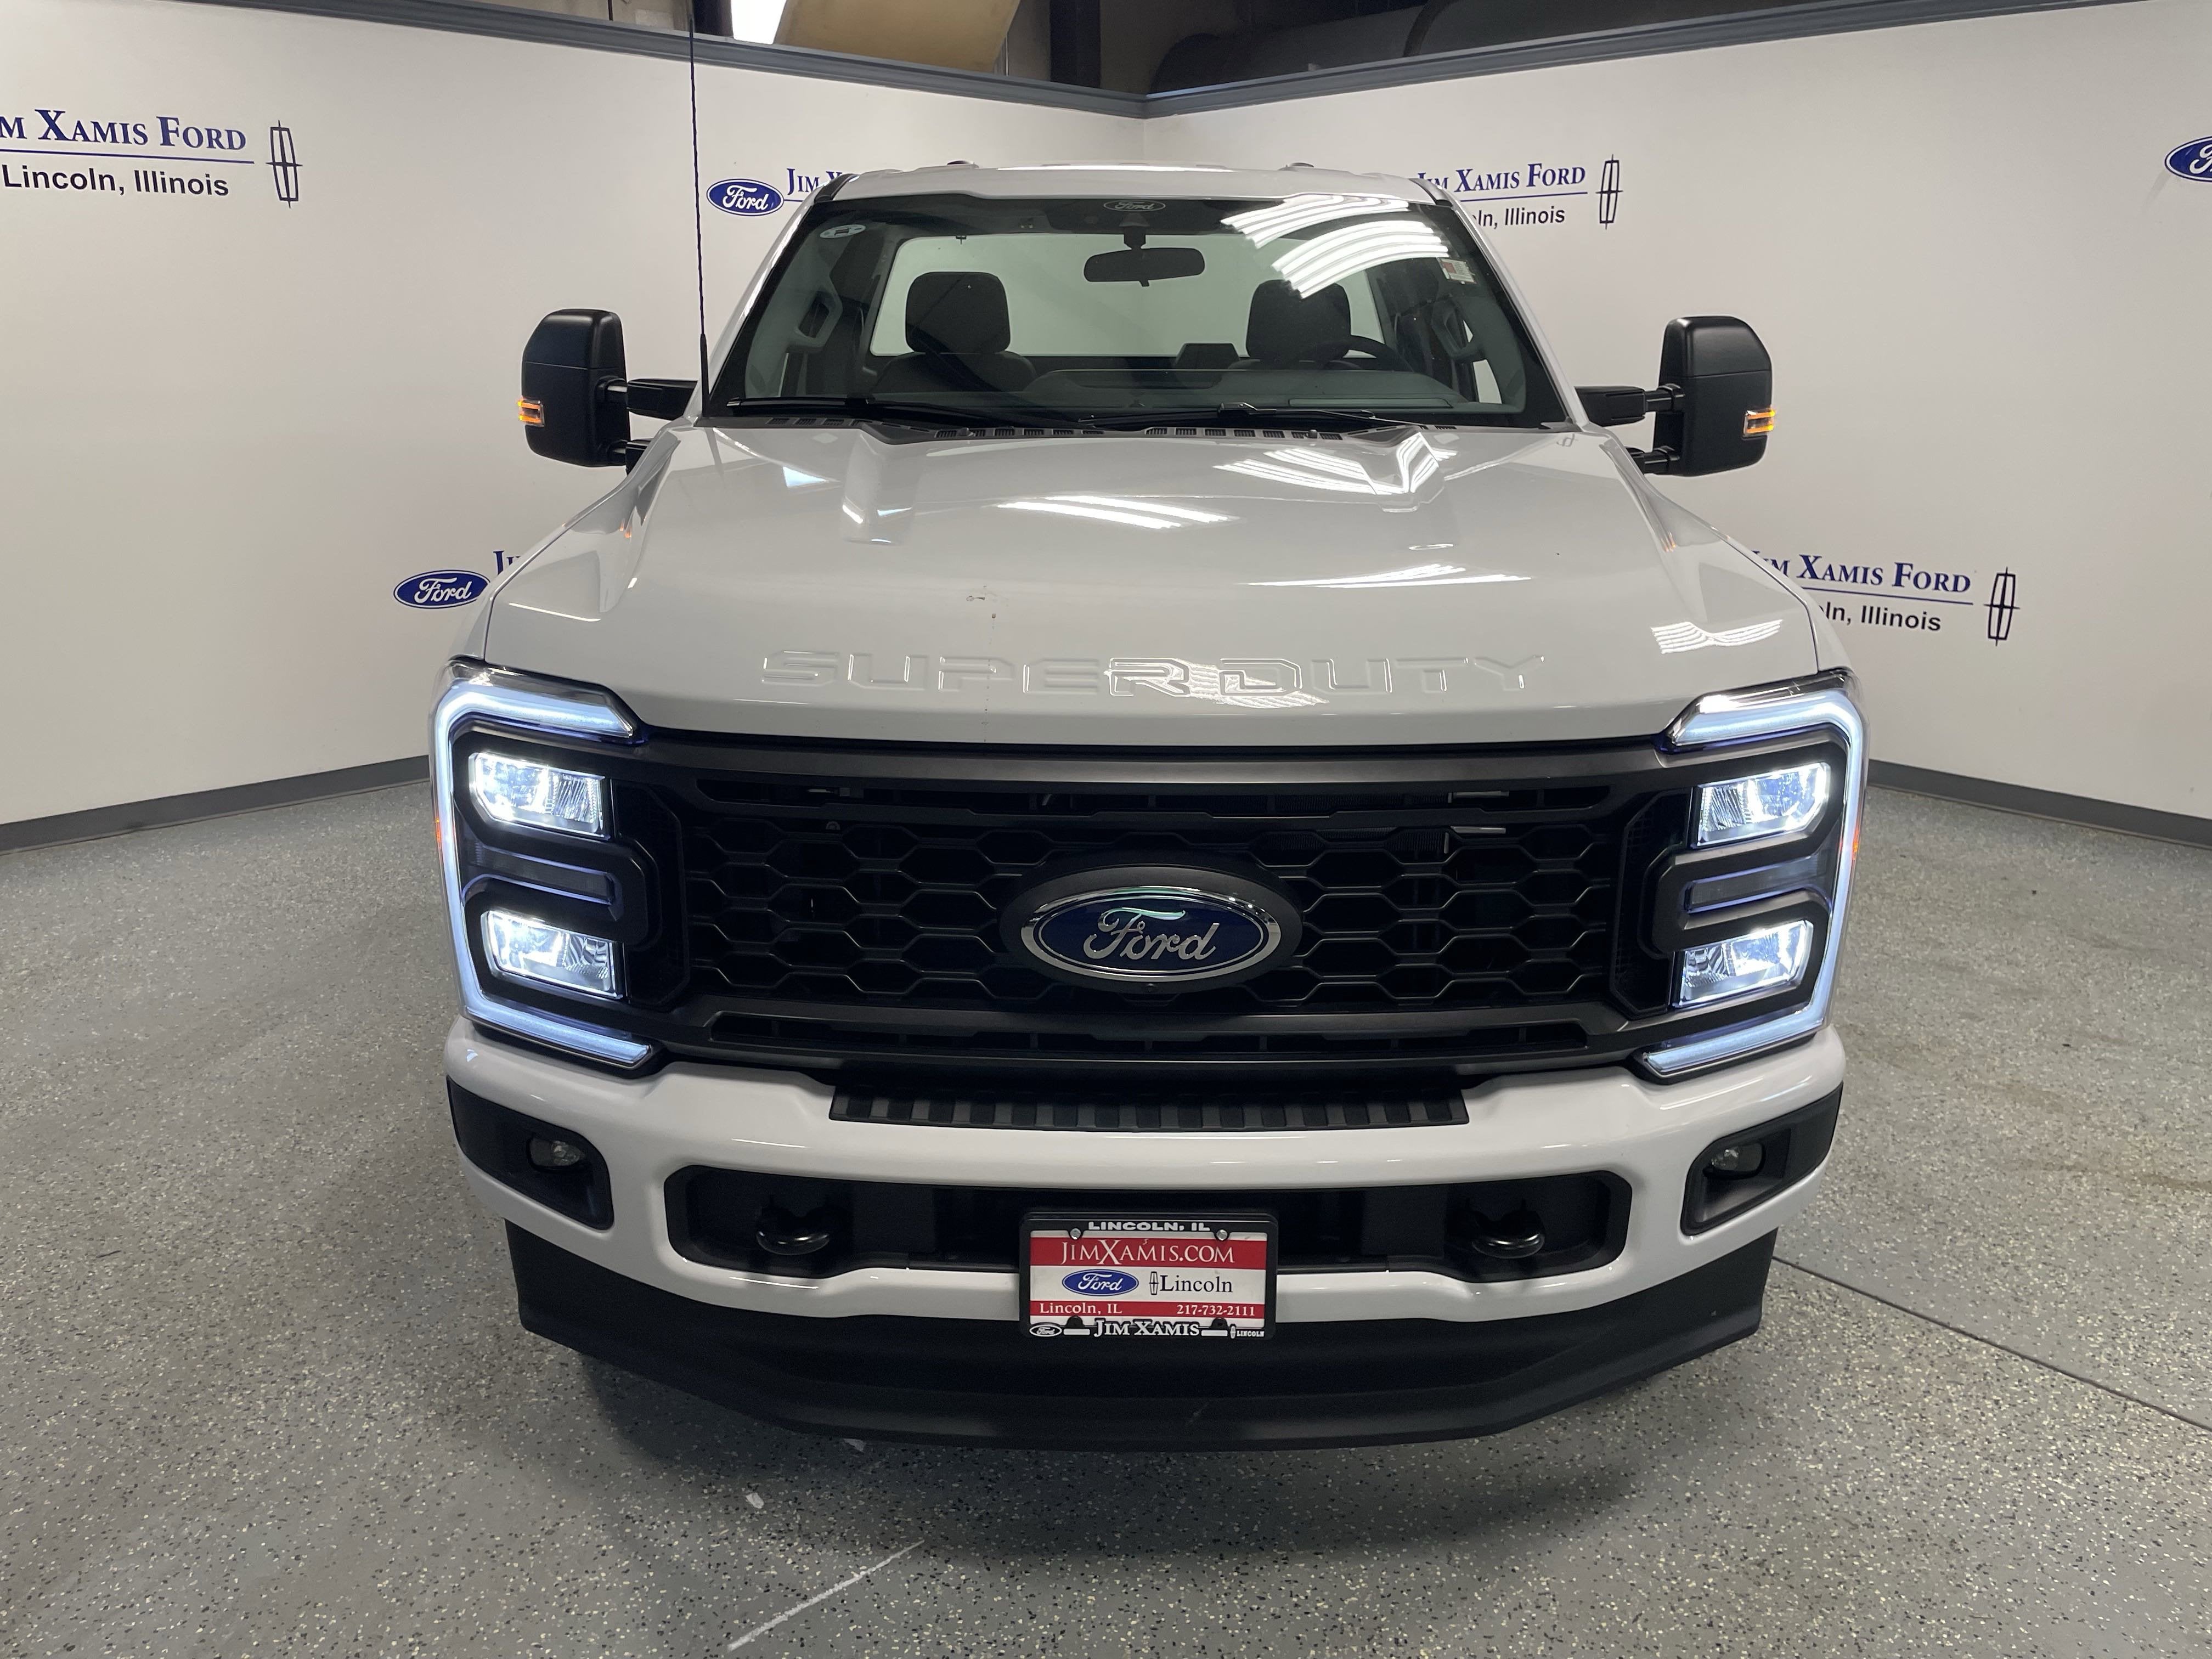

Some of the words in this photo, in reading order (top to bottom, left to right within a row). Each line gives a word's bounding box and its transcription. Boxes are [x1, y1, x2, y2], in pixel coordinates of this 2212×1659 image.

[35, 109, 148, 145] XAMIS
[156, 116, 246, 150] FORD
[2, 164, 124, 195] Lincoln,
[134, 170, 229, 196] Illinois
[787, 168, 820, 195] JIM
[1454, 168, 1520, 193] XAMIS
[1526, 163, 1585, 188] FORD
[722, 184, 769, 211] Ford
[1114, 201, 1155, 210] Ford
[1505, 206, 1565, 225] Illinois
[1796, 554, 1883, 586] XAMIS
[1891, 562, 1971, 593] FORD
[414, 577, 472, 603] Ford
[1861, 605, 1942, 631] Illinois
[761, 650, 1189, 697] SUPER
[1218, 654, 1545, 695] DUTY
[1083, 906, 1220, 961] Ford
[1088, 1221, 1184, 1231] LINCOLN,
[1191, 1222, 1210, 1232] IL
[1077, 1272, 1122, 1291] Ford
[1159, 1275, 1233, 1293] Lincoln
[1040, 1302, 1101, 1316] Lincoln,
[1107, 1303, 1123, 1314] IL
[1177, 1304, 1255, 1317] 217-732-2111
[1093, 1319, 1130, 1338] JIM
[1133, 1321, 1200, 1337] XAMIS
